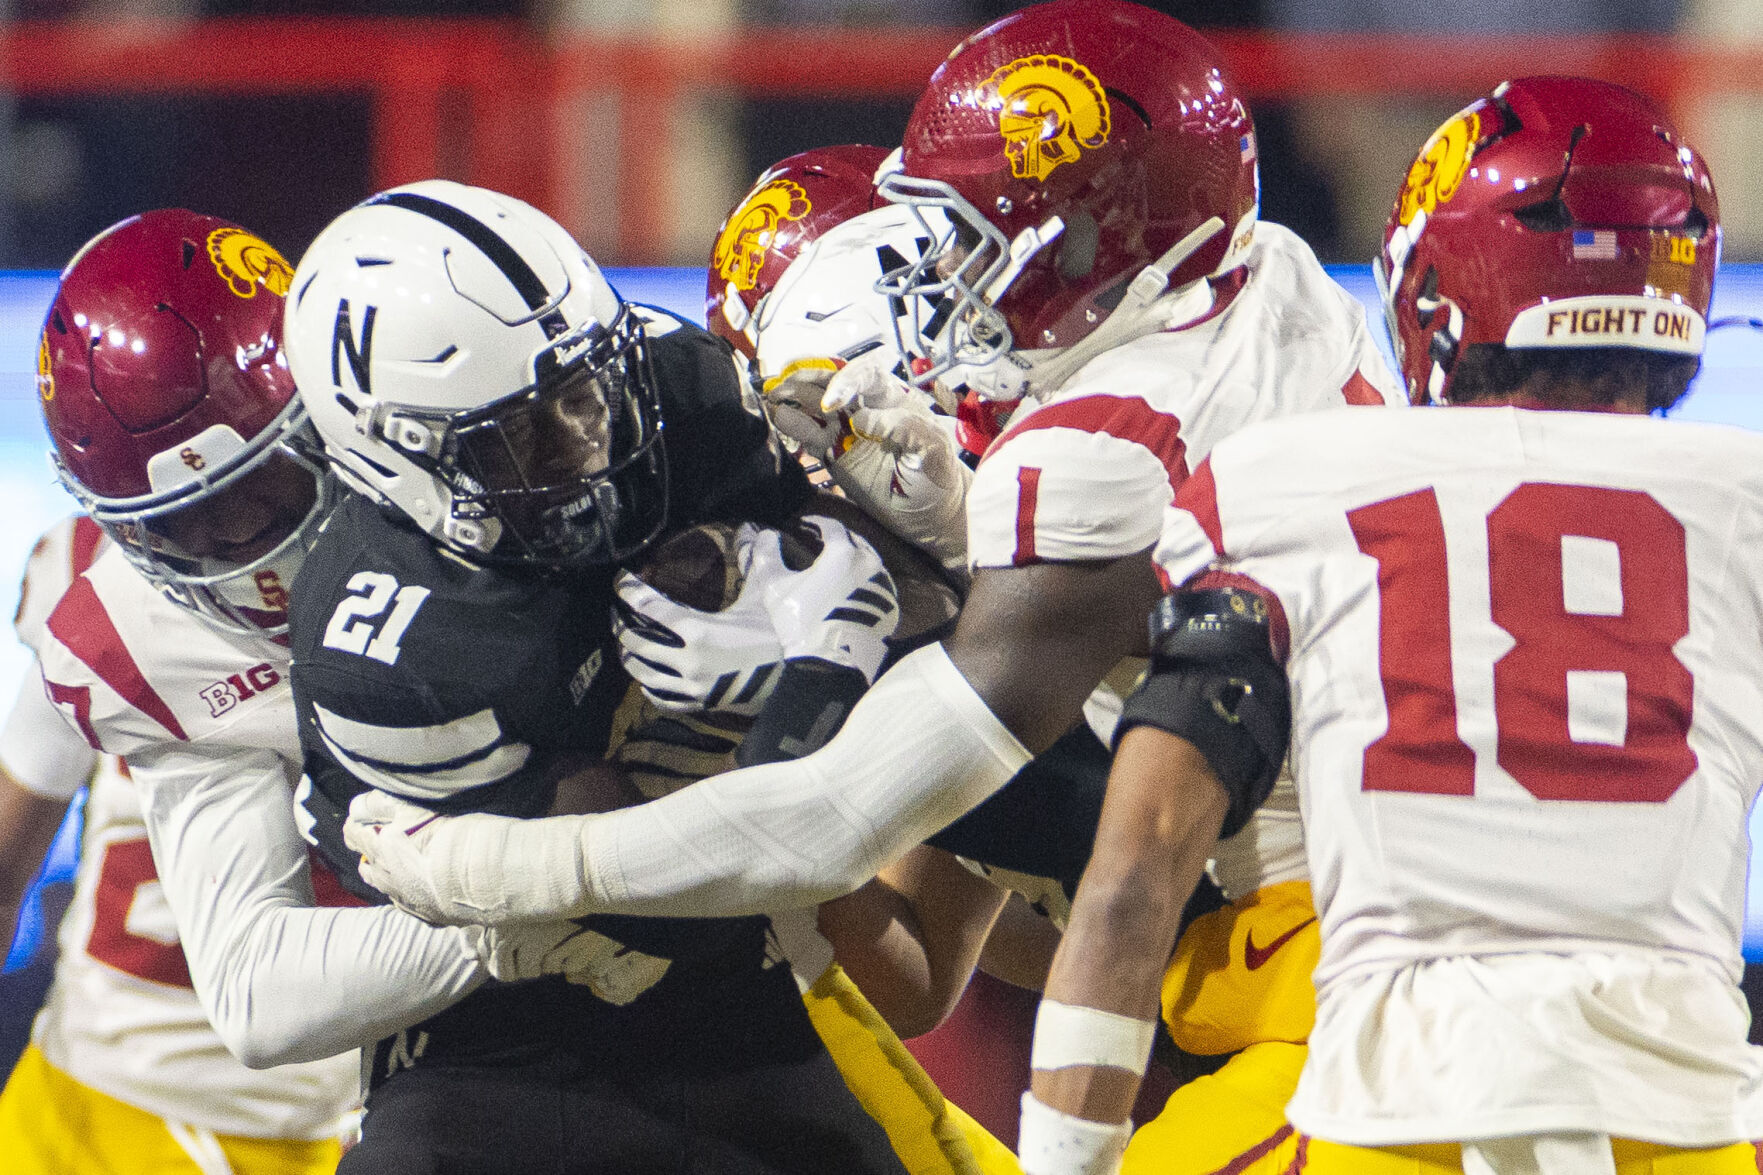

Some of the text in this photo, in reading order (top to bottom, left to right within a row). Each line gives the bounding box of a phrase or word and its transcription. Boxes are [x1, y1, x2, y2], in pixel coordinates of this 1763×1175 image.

[331, 297, 378, 395] N
[1546, 308, 1691, 341] FIGHT ON!
[323, 570, 432, 666] 21
[1345, 481, 1699, 803] 18
[46, 679, 104, 752] 7
